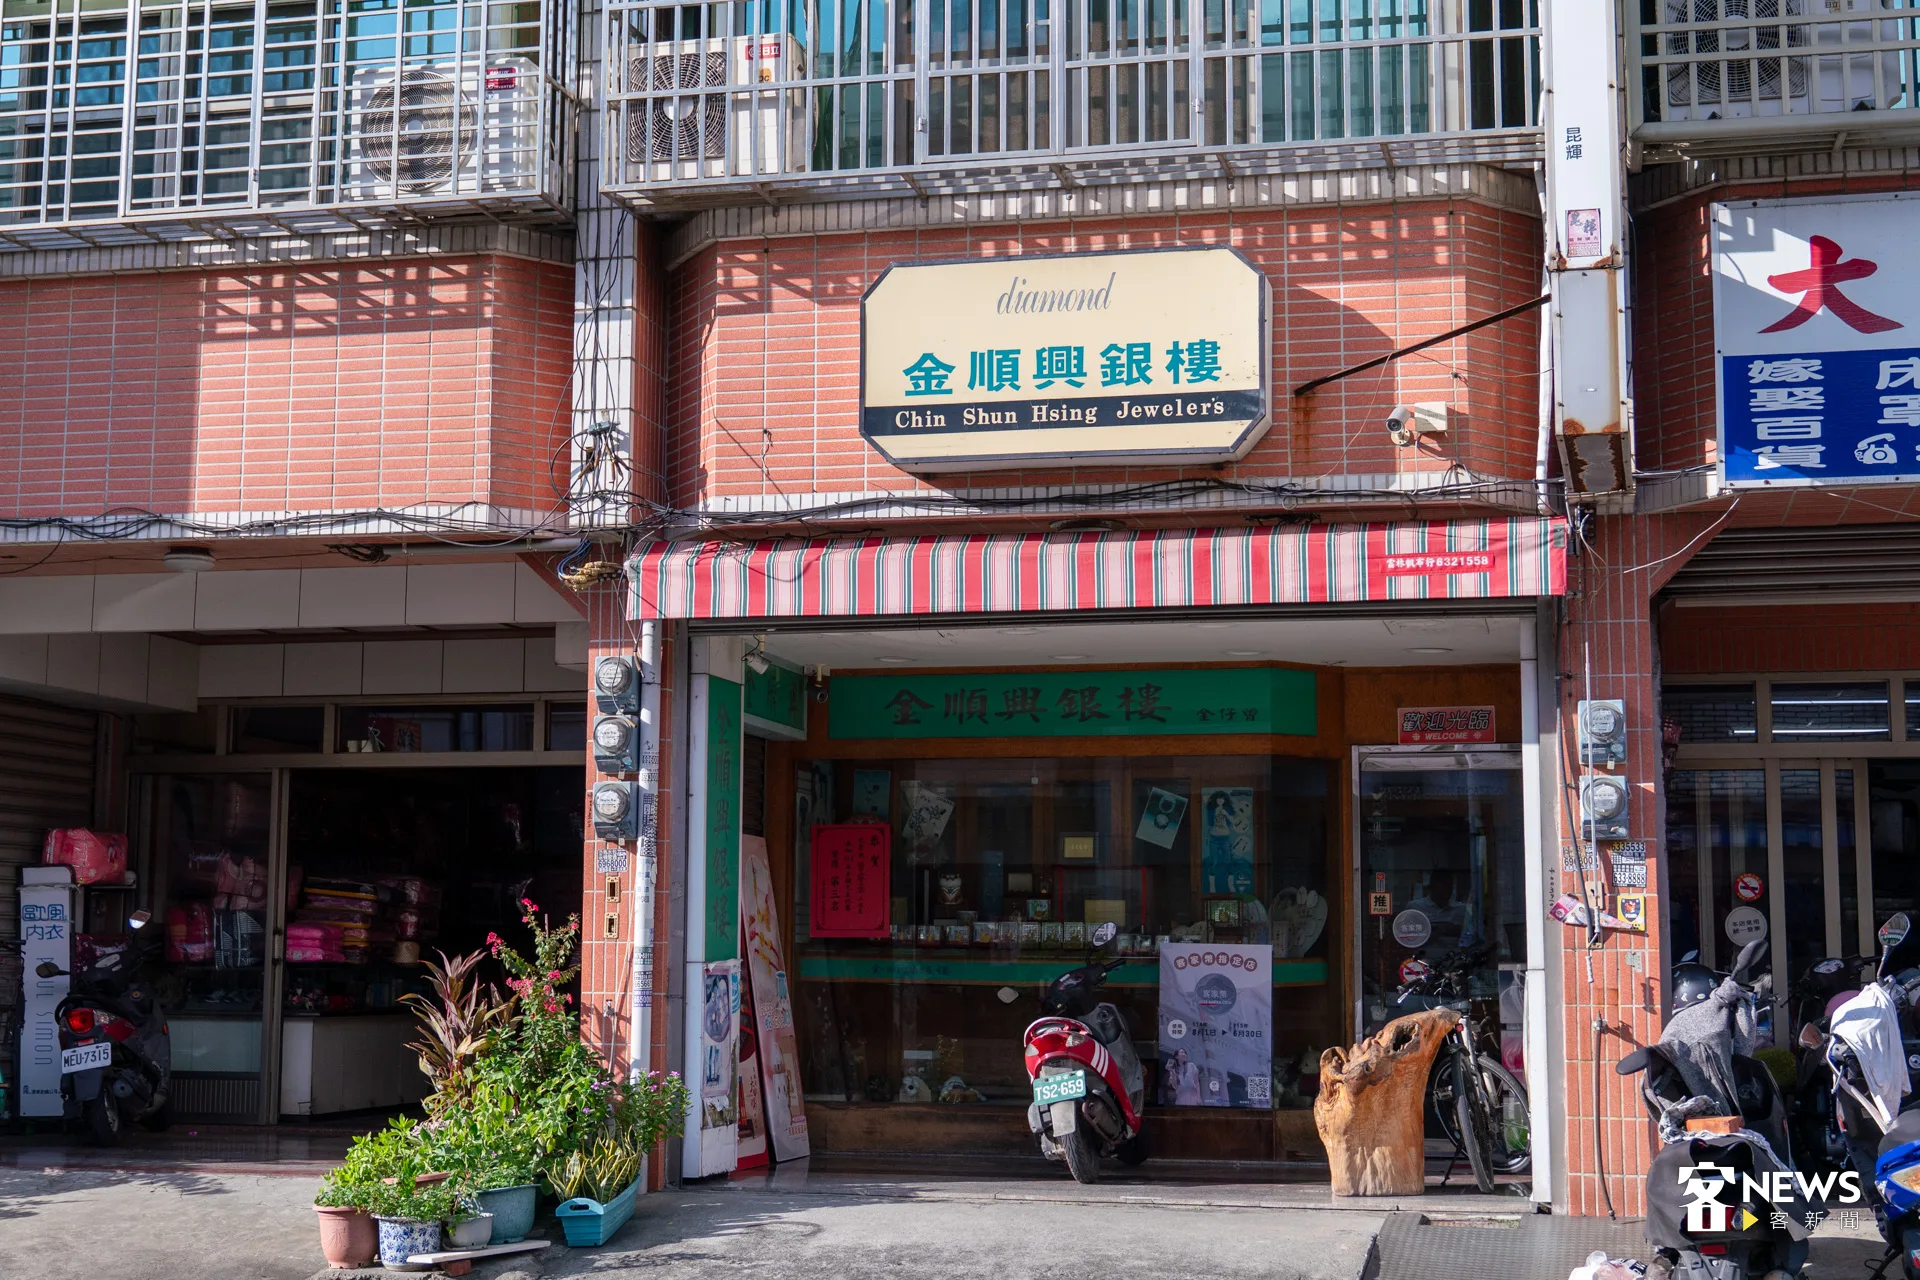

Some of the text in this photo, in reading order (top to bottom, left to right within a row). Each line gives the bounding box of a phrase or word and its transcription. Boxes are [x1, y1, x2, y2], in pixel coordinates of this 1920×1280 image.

[762, 46, 779, 55] 日立
[1565, 126, 1582, 160] 昆輝
[995, 271, 1117, 315] diamond
[1757, 234, 1905, 334] 大
[902, 338, 1222, 397] 金順興銀樓
[895, 398, 1225, 430] Chin Shun Hsing Jeweler's
[1748, 358, 1827, 471] 嫁娶百貨
[882, 682, 1172, 726] 金順興銀樓
[1402, 710, 1490, 731] 歡迎光臨
[1424, 732, 1468, 740] WELCOME
[712, 701, 733, 942] 金順興銀樓
[1611, 842, 1645, 852] 6335533
[598, 859, 627, 868] 6968000
[1613, 872, 1646, 884] 633-8888
[1374, 895, 1387, 907] 推
[1732, 919, 1760, 927] 本店免用
[1732, 926, 1760, 934] 統一發票
[1174, 952, 1257, 971] 客家幣指定店
[1202, 989, 1228, 999] 客家幣
[1192, 1028, 1263, 1038] 8月1日 6月30日
[63, 1048, 110, 1067] MEU-7315
